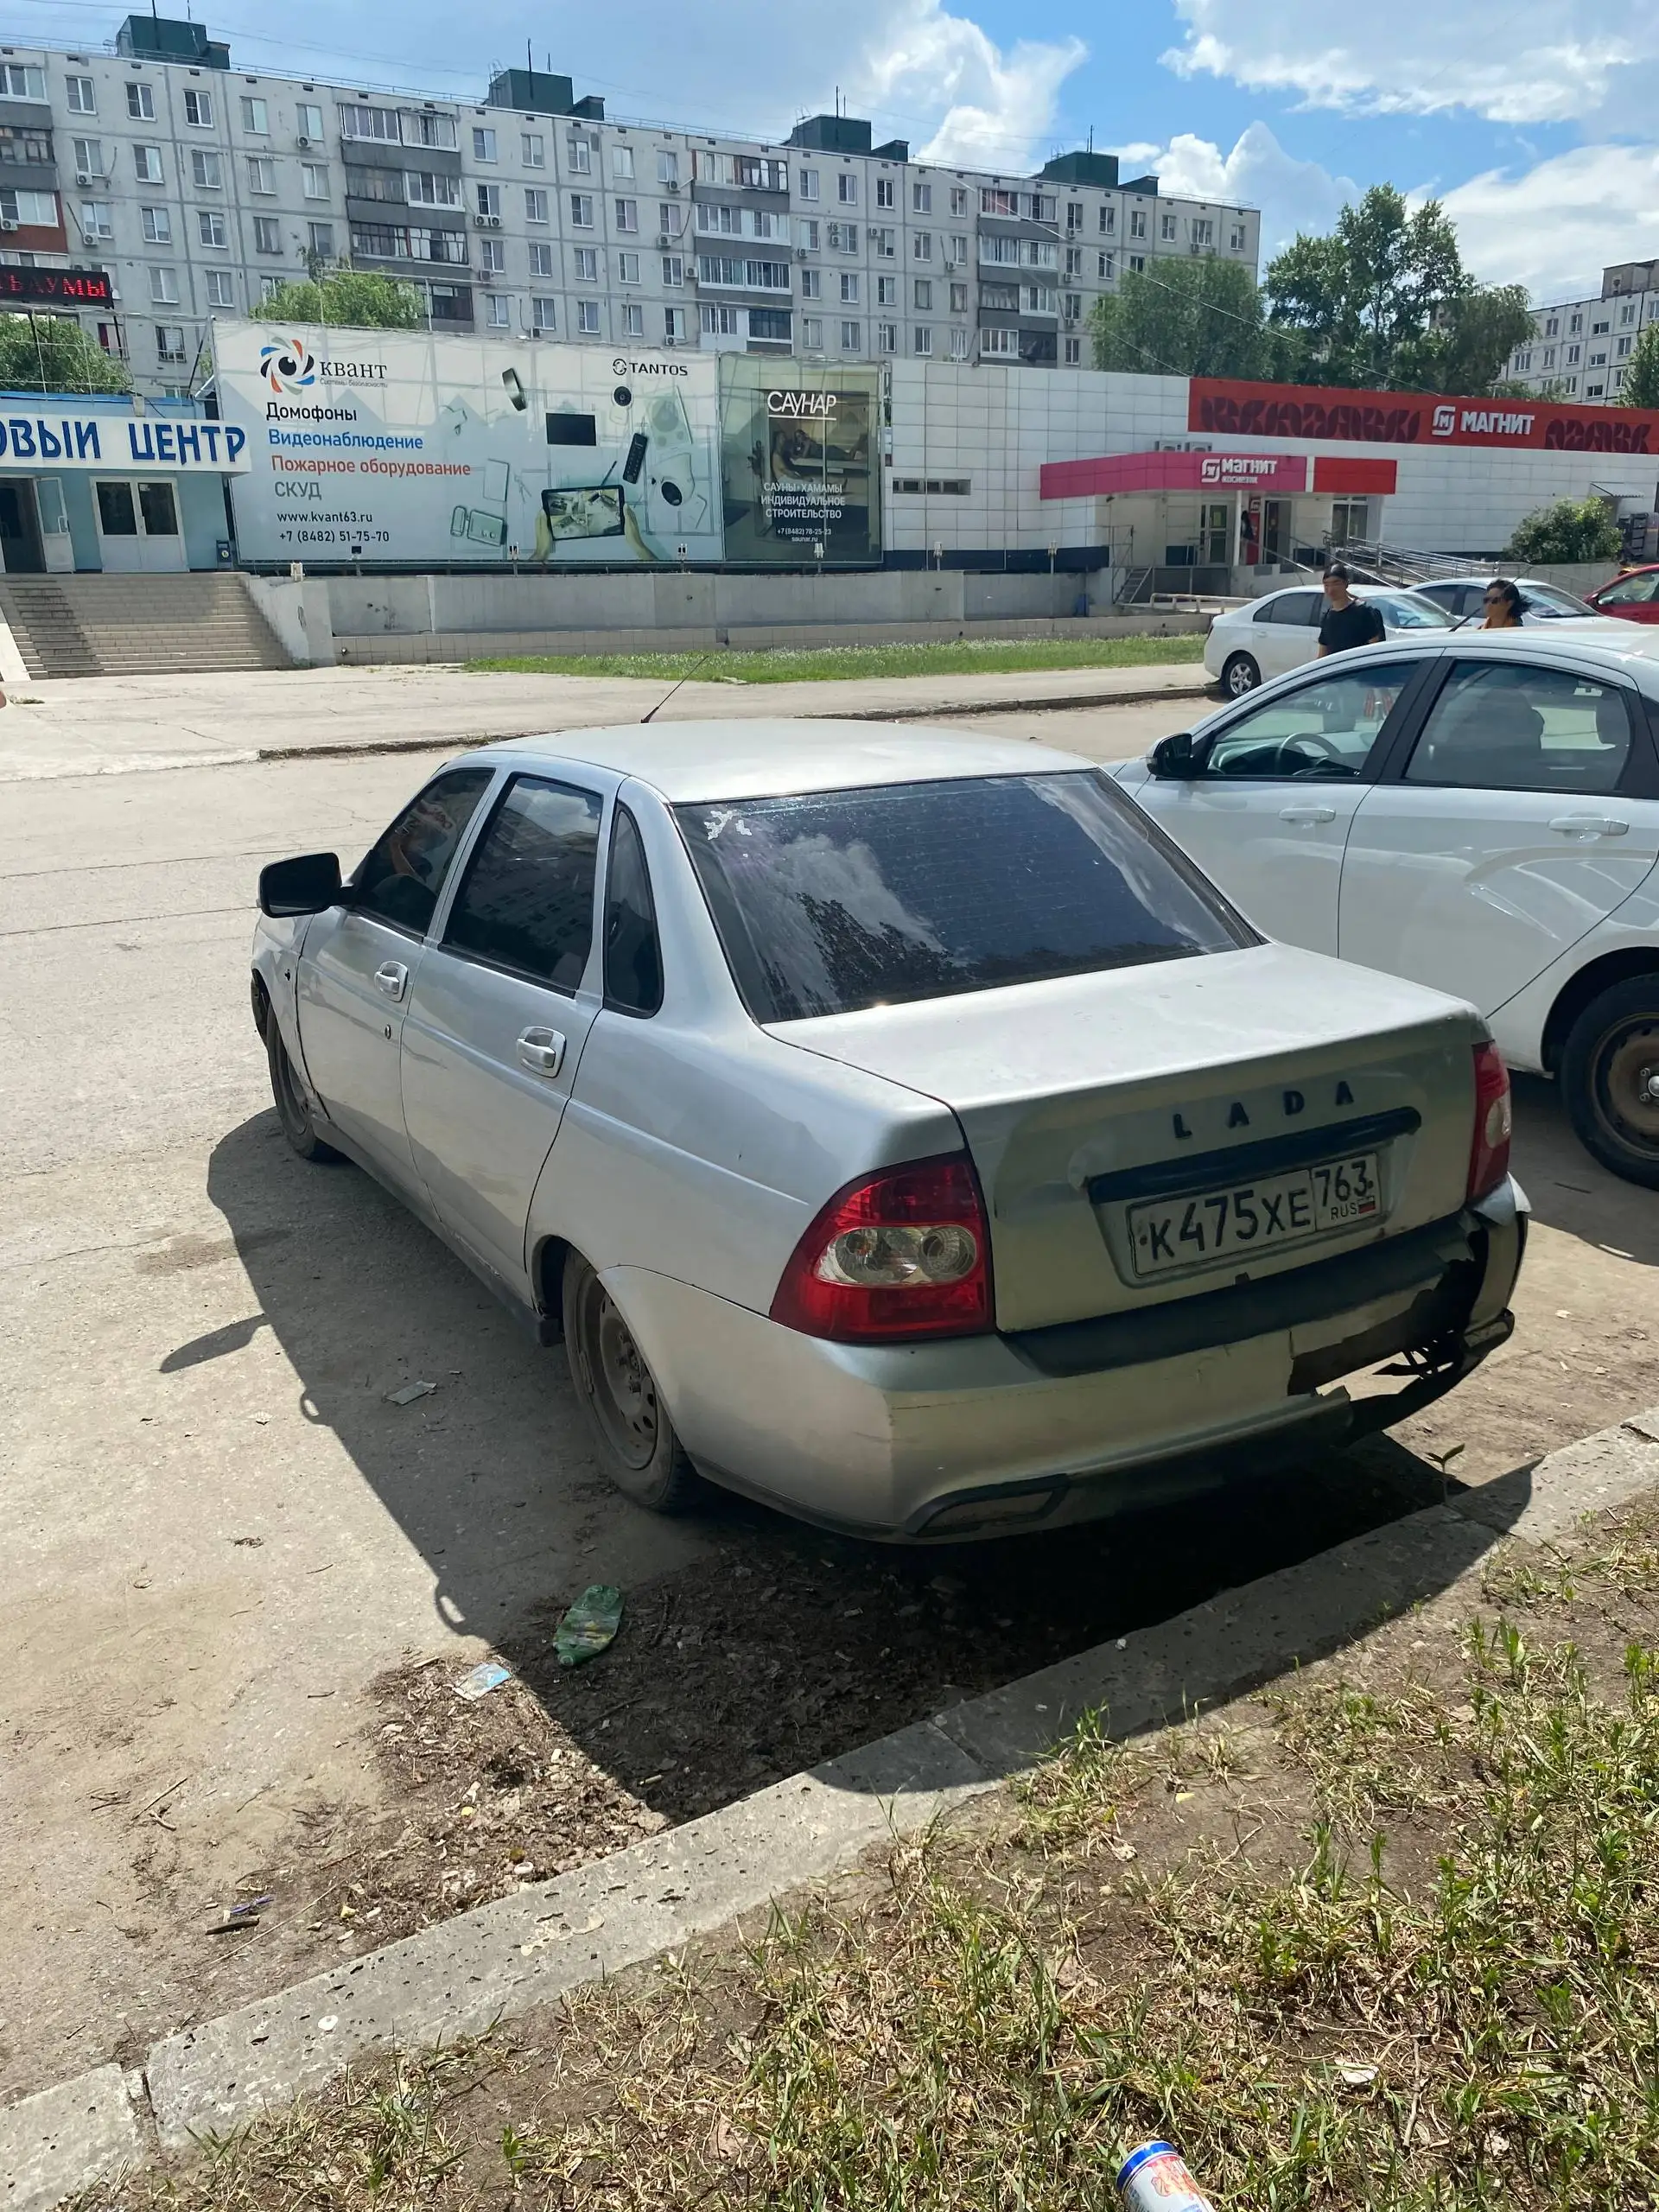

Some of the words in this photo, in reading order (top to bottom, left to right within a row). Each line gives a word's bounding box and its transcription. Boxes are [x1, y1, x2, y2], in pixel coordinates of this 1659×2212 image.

[320, 361, 387, 378] квант
[629, 362, 688, 376] TANTOS
[266, 402, 357, 422] Домофоны
[767, 391, 836, 417] САУНАР
[1460, 410, 1535, 435] МАГНИТ
[129, 423, 245, 466] ЦЕНТР
[269, 429, 423, 450] Видеонаблюдение
[271, 454, 355, 475] Пожарное
[359, 458, 471, 478] оборудование
[274, 481, 321, 500] СКУД
[764, 482, 796, 492] САУНЫ
[801, 483, 842, 493] ХАМАМЫ
[760, 495, 845, 507] ИНДИВИДУАЛЬНОЕ
[276, 511, 373, 523] www.kvant63.ru
[766, 508, 842, 518] СТРОИТЕЛЬСТВО
[279, 531, 292, 542] +7
[297, 530, 335, 543] (8482)
[340, 531, 390, 542] 51-75-70
[1173, 1080, 1355, 1140] LADA
[1315, 1160, 1366, 1207] 763
[1331, 1202, 1357, 1220] RUS
